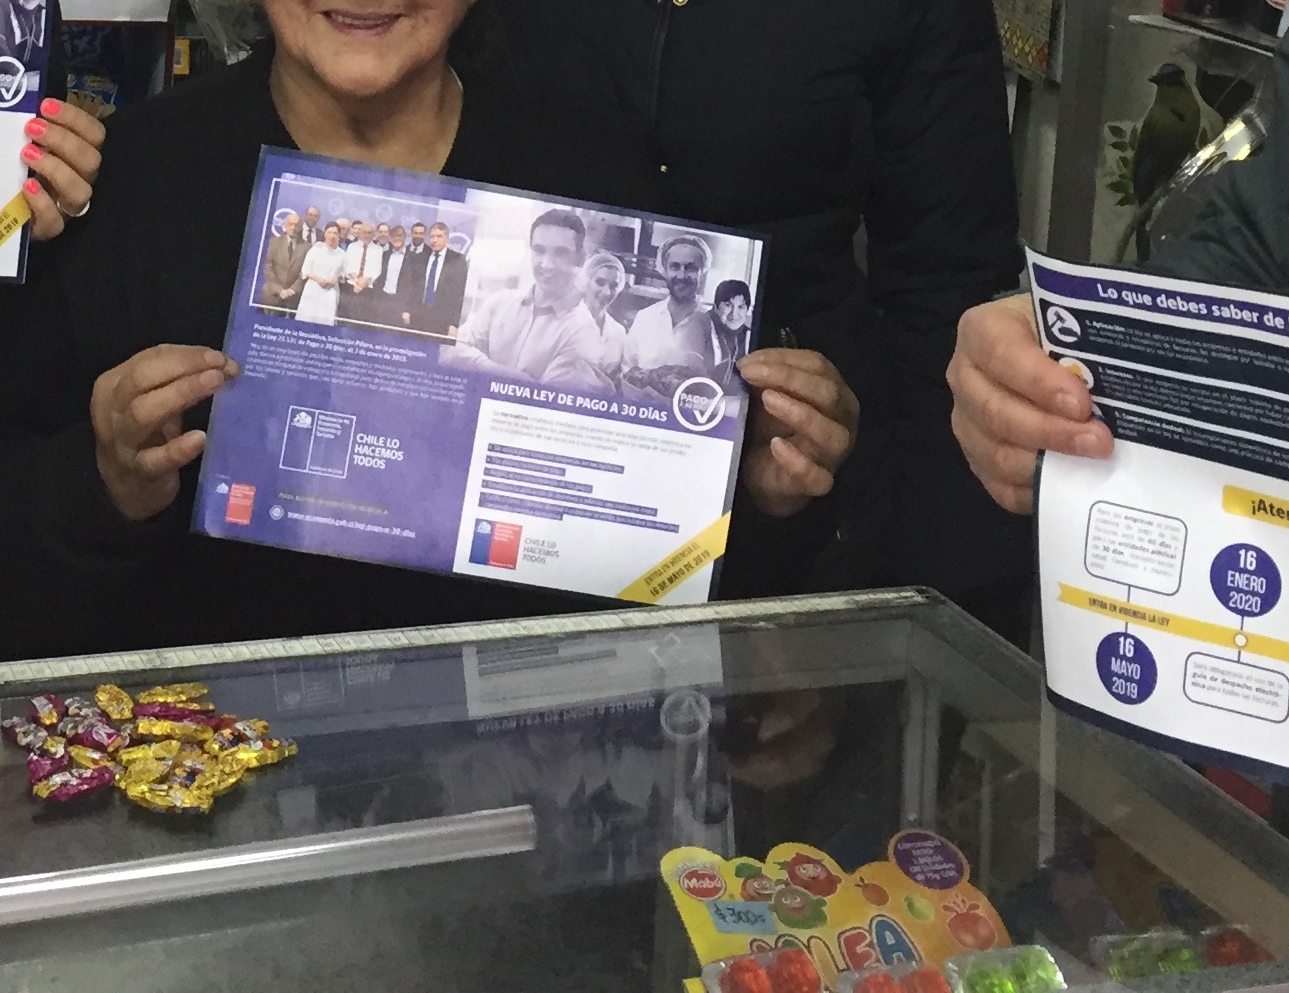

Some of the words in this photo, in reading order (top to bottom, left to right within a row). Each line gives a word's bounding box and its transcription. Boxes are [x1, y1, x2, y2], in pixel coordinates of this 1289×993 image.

[1097, 283, 1118, 300] Lo
[1122, 290, 1152, 307] que
[1156, 294, 1208, 315] debes
[1211, 303, 1260, 324] saber
[1263, 313, 1285, 329] de
[490, 381, 530, 399] NUEVA
[533, 389, 555, 403] LEY
[558, 393, 573, 406] DE
[575, 397, 609, 412] PAGO
[609, 402, 618, 413] A
[621, 404, 637, 418] 30
[638, 406, 668, 423] DÍAS
[356, 433, 385, 447] CHILE
[386, 438, 400, 449] LO
[353, 456, 386, 470] TODOS
[354, 444, 403, 461] HACEMOS
[1238, 549, 1257, 571] 16
[1227, 573, 1266, 594] ENERO
[1229, 593, 1261, 613] 2020
[1118, 636, 1134, 657] 16
[1111, 657, 1141, 680] MAYO
[1112, 676, 1138, 698] 2019
